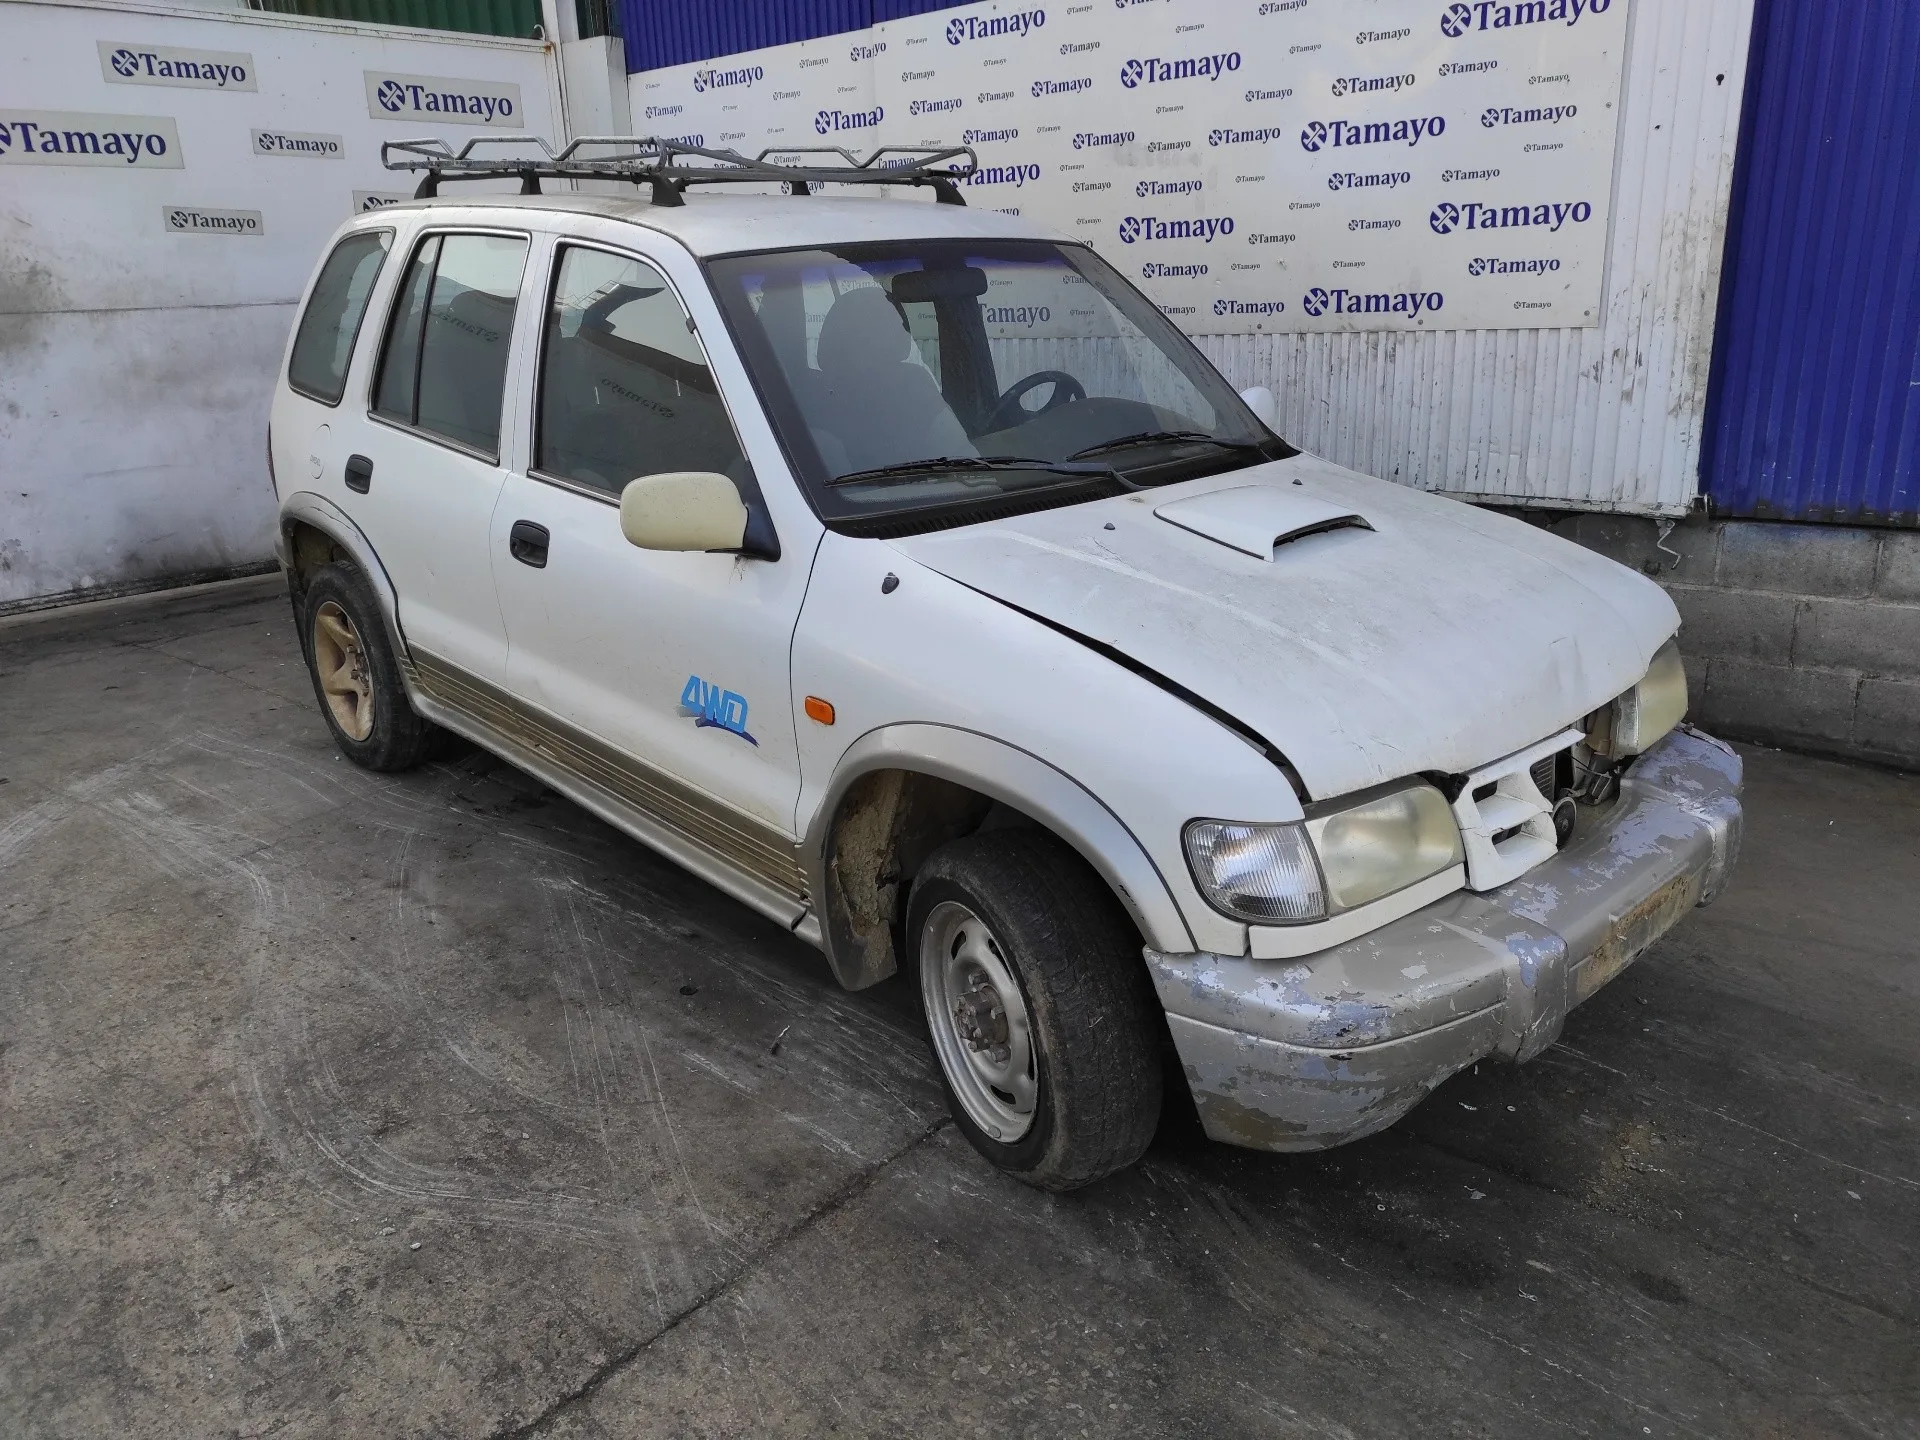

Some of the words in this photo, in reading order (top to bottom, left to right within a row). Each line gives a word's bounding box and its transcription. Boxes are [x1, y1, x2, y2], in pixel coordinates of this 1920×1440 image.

[1473, 0, 1611, 31] Tamayo
[965, 9, 1045, 40] Tamayo
[1182, 23, 1205, 33] Tamayo
[1367, 27, 1410, 43] Tamayo
[1068, 41, 1100, 54] Tamayo
[1296, 43, 1321, 53] Tamayo
[139, 53, 246, 85] Tamayo
[805, 57, 829, 67] Tamayo
[1144, 51, 1241, 84] Tamayo
[1451, 59, 1498, 75] Tamayo
[708, 66, 763, 88] Tamayo
[909, 70, 935, 80] Tamayo
[1536, 73, 1569, 84] Tamayo
[1043, 77, 1092, 96] Tamayo
[1349, 73, 1415, 94] Tamayo
[779, 91, 801, 100] Tamayo
[984, 90, 1014, 103] Tamayo
[1255, 88, 1293, 101] Tamayo
[406, 85, 513, 121] Tamayo
[652, 104, 683, 117] Tamayo
[920, 98, 962, 113] Tamayo
[1161, 105, 1184, 113] Tamayo
[1500, 104, 1577, 125] Tamayo
[724, 132, 746, 141] Tamayo
[974, 128, 1018, 143] Tamayo
[1085, 129, 1135, 148] Tamayo
[1223, 127, 1281, 145] Tamayo
[1329, 115, 1445, 147] Tamayo
[11, 122, 166, 162] Tamayo
[275, 135, 338, 155] Tamayo
[1156, 139, 1191, 152] Tamayo
[1532, 142, 1563, 151] Tamayo
[1065, 164, 1085, 172] Tamayo
[1454, 168, 1500, 181] Tamayo
[1242, 175, 1265, 183] Tamayo
[1345, 171, 1410, 188] Tamayo
[1081, 181, 1111, 193] Tamayo
[1149, 179, 1202, 196] Tamayo
[1295, 202, 1320, 210] Tamayo
[188, 213, 256, 232] Tamayo
[1462, 200, 1591, 232] Tamayo
[1141, 216, 1234, 243] Tamayo
[1359, 218, 1401, 230] Tamayo
[1258, 233, 1296, 244] Tamayo
[1156, 263, 1208, 279] Tamayo
[1339, 260, 1365, 268] Tamayo
[1486, 258, 1560, 276] Tamayo
[1163, 305, 1196, 315] Tamayo
[1227, 300, 1285, 316] Tamayo
[1330, 290, 1443, 319] Tamayo
[1522, 301, 1551, 310] Tamayo
